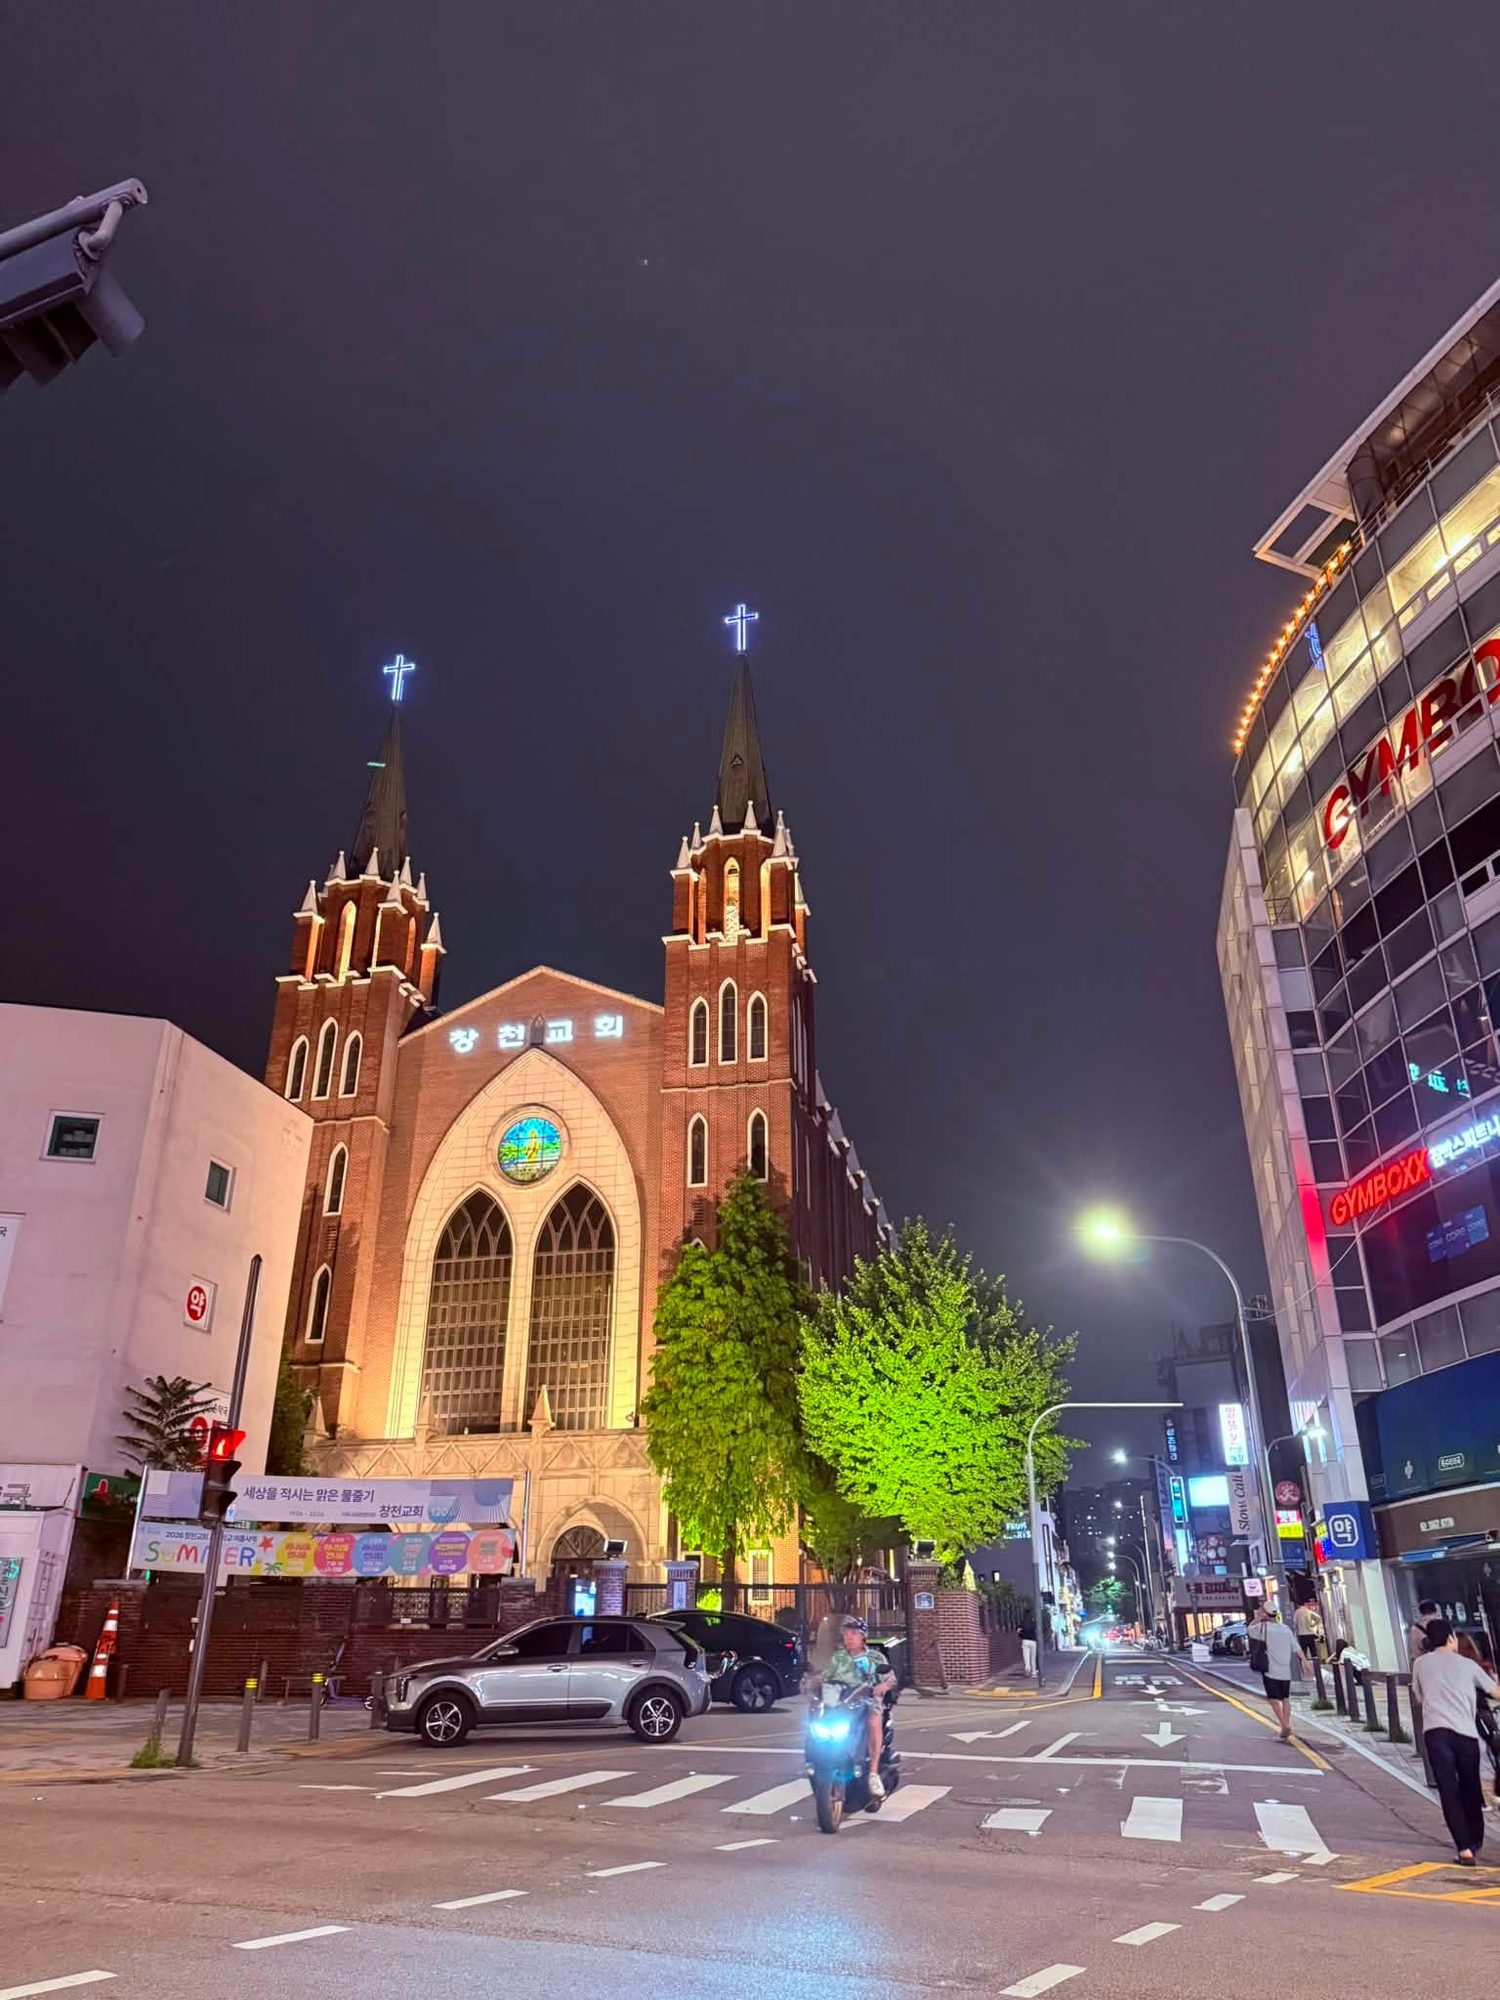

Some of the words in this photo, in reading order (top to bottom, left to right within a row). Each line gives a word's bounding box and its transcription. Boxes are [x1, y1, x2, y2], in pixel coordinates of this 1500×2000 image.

[449, 1014, 624, 1053] 창천교회
[1332, 1147, 1430, 1225] GYMBOXX
[190, 1289, 206, 1317] 약
[243, 1486, 278, 1501] 세상을
[280, 1487, 315, 1502] 적시는
[316, 1488, 339, 1502] 맑은
[341, 1489, 375, 1504] 물줄기
[379, 1505, 424, 1518] 창천교회
[1333, 1518, 1353, 1543] 약
